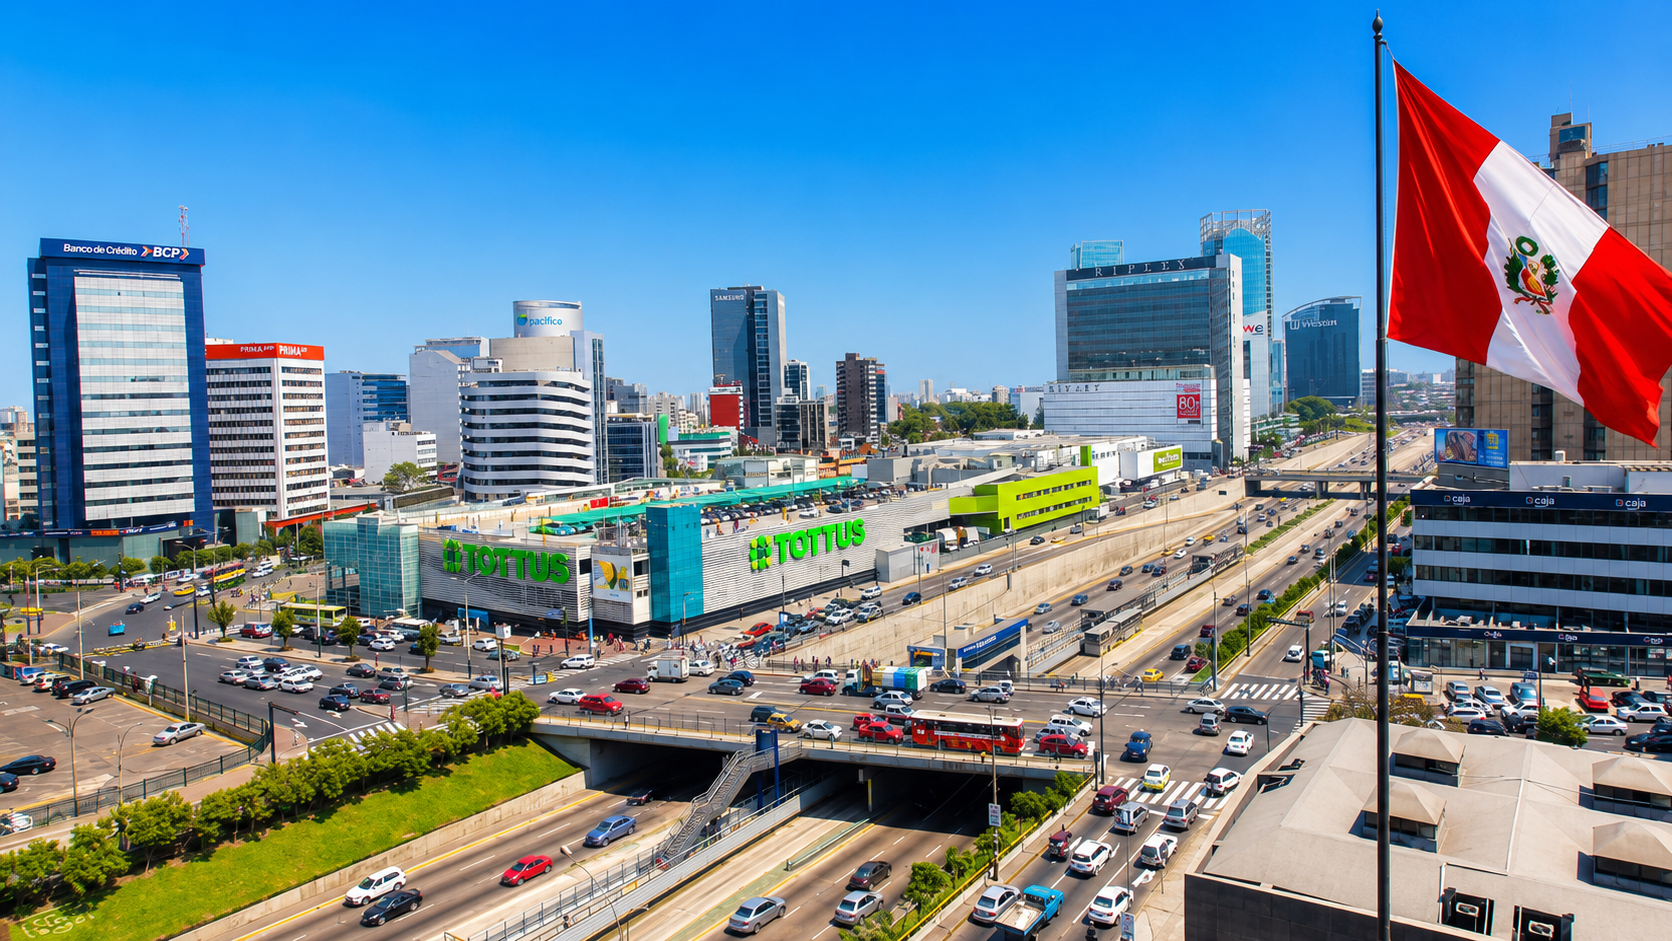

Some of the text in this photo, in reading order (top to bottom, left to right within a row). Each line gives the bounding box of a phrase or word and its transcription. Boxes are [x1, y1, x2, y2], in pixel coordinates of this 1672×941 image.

[63, 243, 180, 259] Banco de Crédito BCP
[279, 345, 301, 356] PRIMA
[1179, 396, 1196, 410] 80
[774, 518, 866, 564] TOTTUS
[462, 543, 570, 584] TOTTUS
